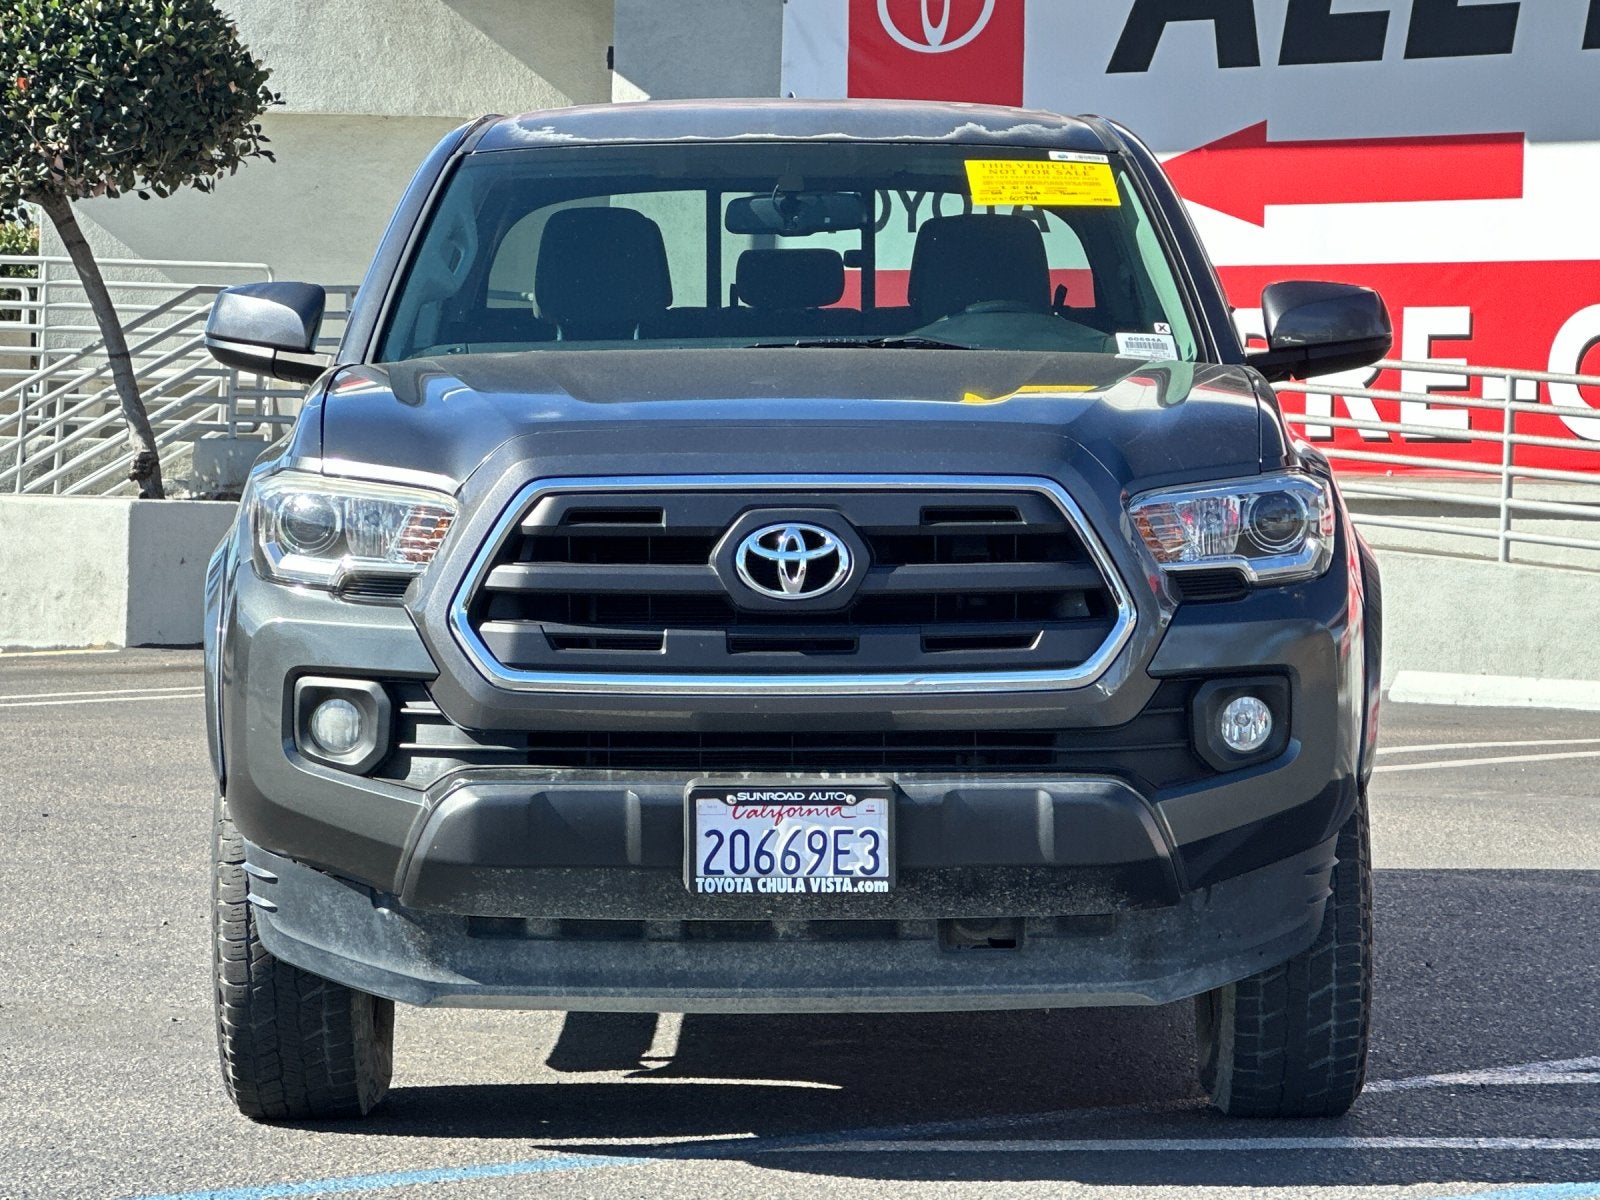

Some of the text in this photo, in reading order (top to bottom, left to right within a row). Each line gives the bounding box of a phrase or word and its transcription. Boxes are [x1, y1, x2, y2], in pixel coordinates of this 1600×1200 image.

[1016, 163, 1077, 171] VEHICLE
[737, 791, 847, 801] SUNROAD AUTO
[732, 804, 857, 826] California
[703, 828, 880, 876] 20669E3
[695, 877, 889, 894] TOYOTA CHULA VISTA.com
